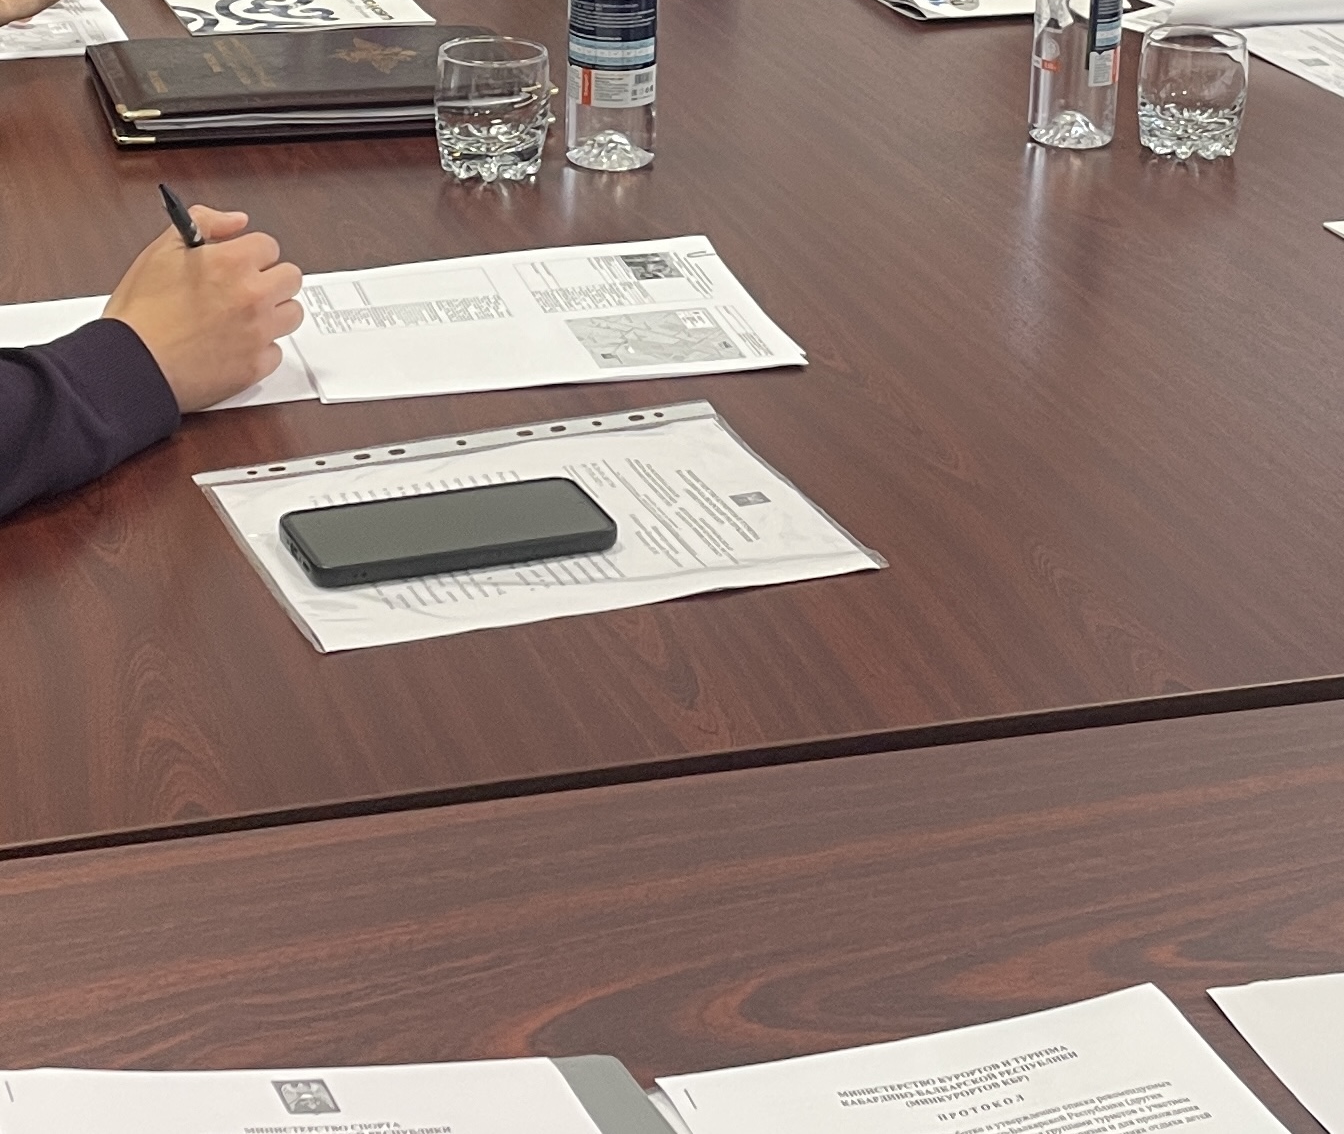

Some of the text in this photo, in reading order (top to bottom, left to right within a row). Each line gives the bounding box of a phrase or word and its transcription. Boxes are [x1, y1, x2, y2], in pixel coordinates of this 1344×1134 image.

[837, 1045, 1068, 1099] МИНИСТЕРСТВО КУРОРТОВ И ТУРИЗМА
[840, 1050, 1078, 1107] КАБАРДИНО-БАЛКАРСКОЙ РЕСПУБЛИКИ
[905, 1073, 1030, 1108] (МИНКУРОРТОВ КБР)
